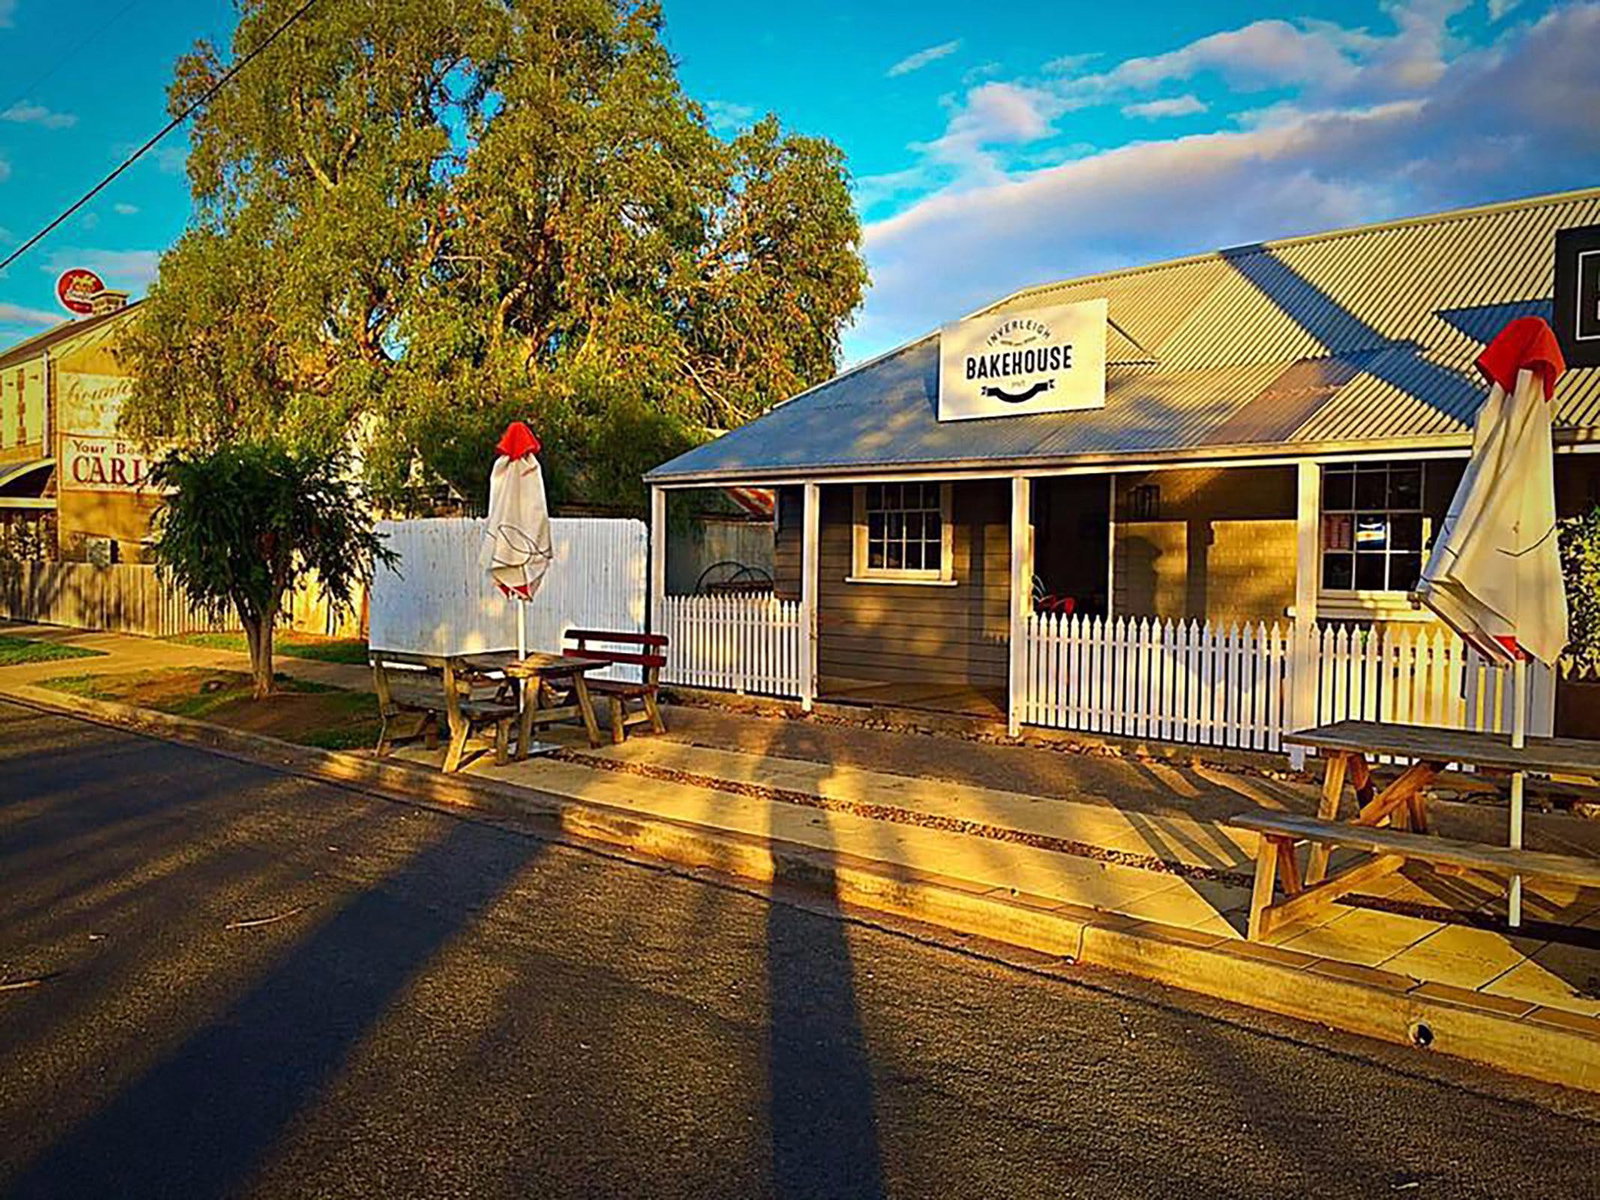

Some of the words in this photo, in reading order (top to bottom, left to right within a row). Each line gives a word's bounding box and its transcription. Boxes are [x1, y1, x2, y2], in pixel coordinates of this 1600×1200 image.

[986, 319, 1051, 347] INVERLEIGH
[966, 345, 1073, 380] BAKEHOUSE
[72, 440, 107, 454] Your
